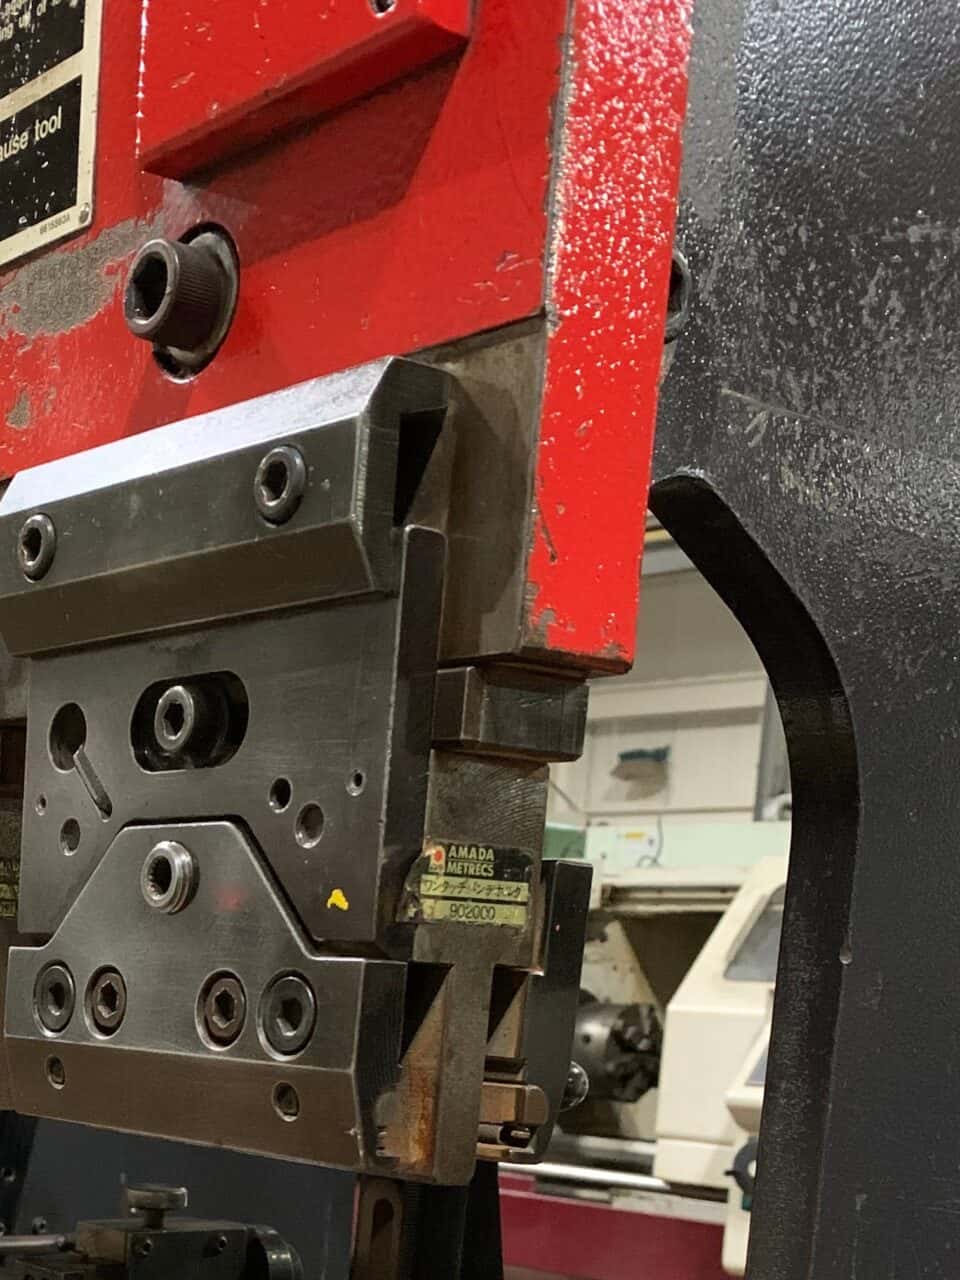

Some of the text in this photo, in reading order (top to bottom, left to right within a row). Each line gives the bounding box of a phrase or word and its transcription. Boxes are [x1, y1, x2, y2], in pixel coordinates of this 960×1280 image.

[34, 105, 62, 142] tool
[448, 845, 494, 861] AMADA
[446, 862, 494, 876] METRECS
